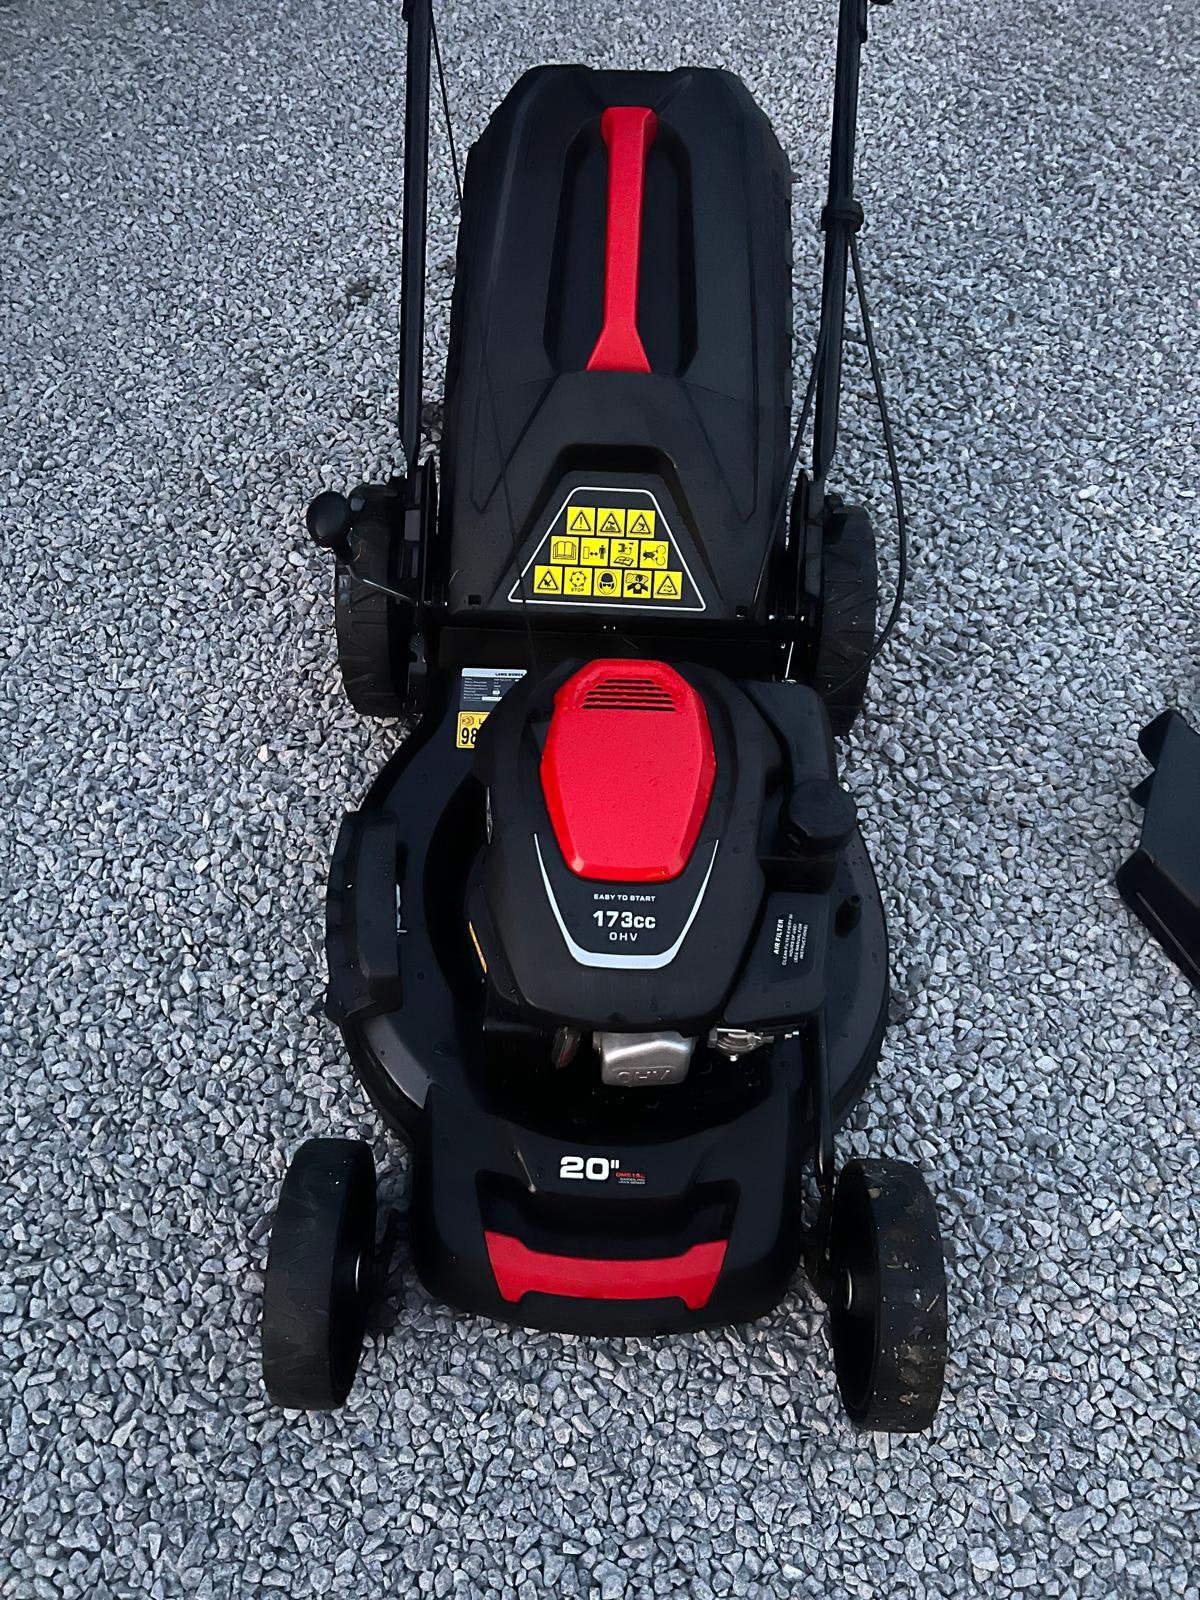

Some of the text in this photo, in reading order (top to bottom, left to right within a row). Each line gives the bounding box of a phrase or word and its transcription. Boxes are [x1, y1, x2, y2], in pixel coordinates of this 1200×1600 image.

[461, 727, 478, 744] 98
[592, 910, 656, 929] 173cc
[609, 931, 638, 941] OHV
[773, 919, 784, 954] AIR FILTER
[560, 1156, 620, 1180] 20"
